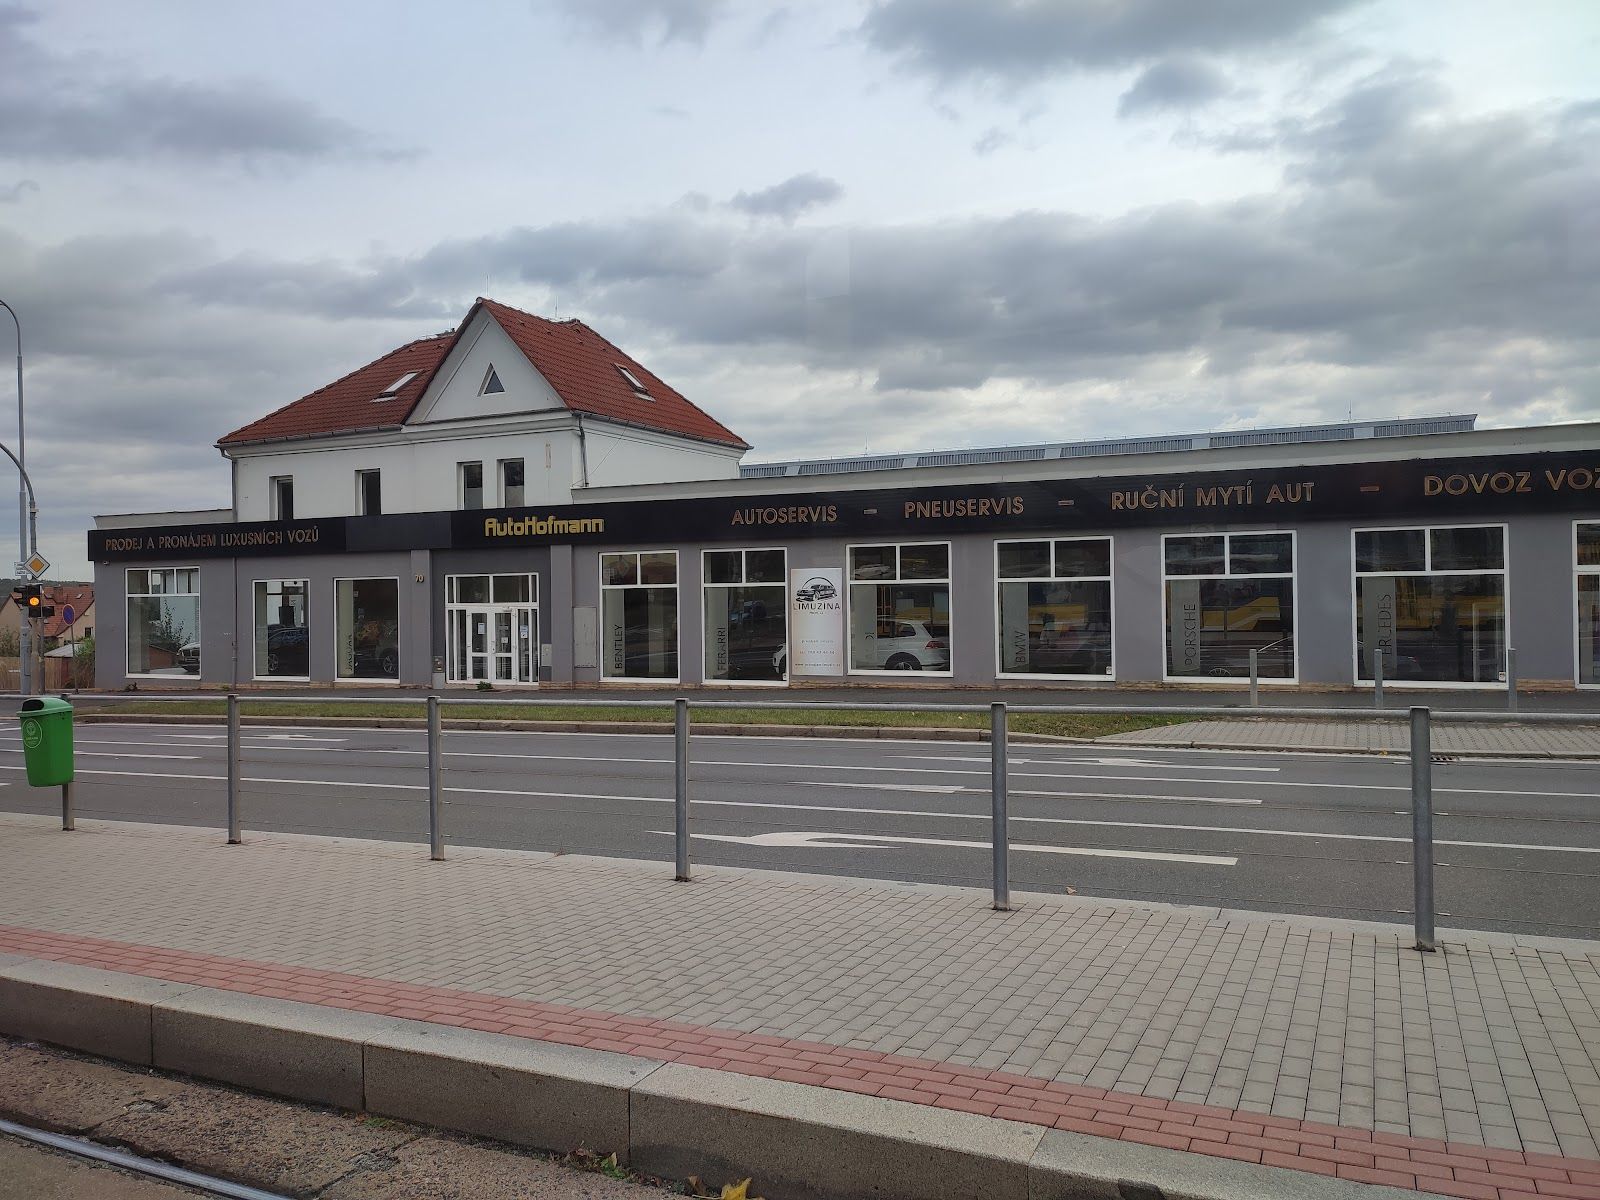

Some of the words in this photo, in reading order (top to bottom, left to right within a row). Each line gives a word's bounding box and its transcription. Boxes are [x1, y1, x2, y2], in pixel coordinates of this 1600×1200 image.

[731, 504, 838, 526] AUTOSERVIS
[904, 496, 1024, 519] PNEUSERVIS
[1111, 485, 1185, 510] RUČNÍ
[1196, 480, 1253, 506] MYTÍ
[1266, 482, 1315, 504] AUT
[1424, 472, 1532, 496] DOVOZ
[105, 537, 143, 551] PRODEJ
[146, 538, 155, 549] A
[158, 532, 216, 549] PRONÁJEM
[220, 528, 283, 546] LUXUSNÍCH
[485, 516, 604, 537] AutoHofmann
[414, 574, 424, 583] 70
[793, 602, 841, 611] LIMUZINA
[614, 624, 623, 669] BENTLEY
[717, 627, 726, 671] FERARRI
[1015, 630, 1026, 663] BMW
[1184, 603, 1196, 665] PORSCHE
